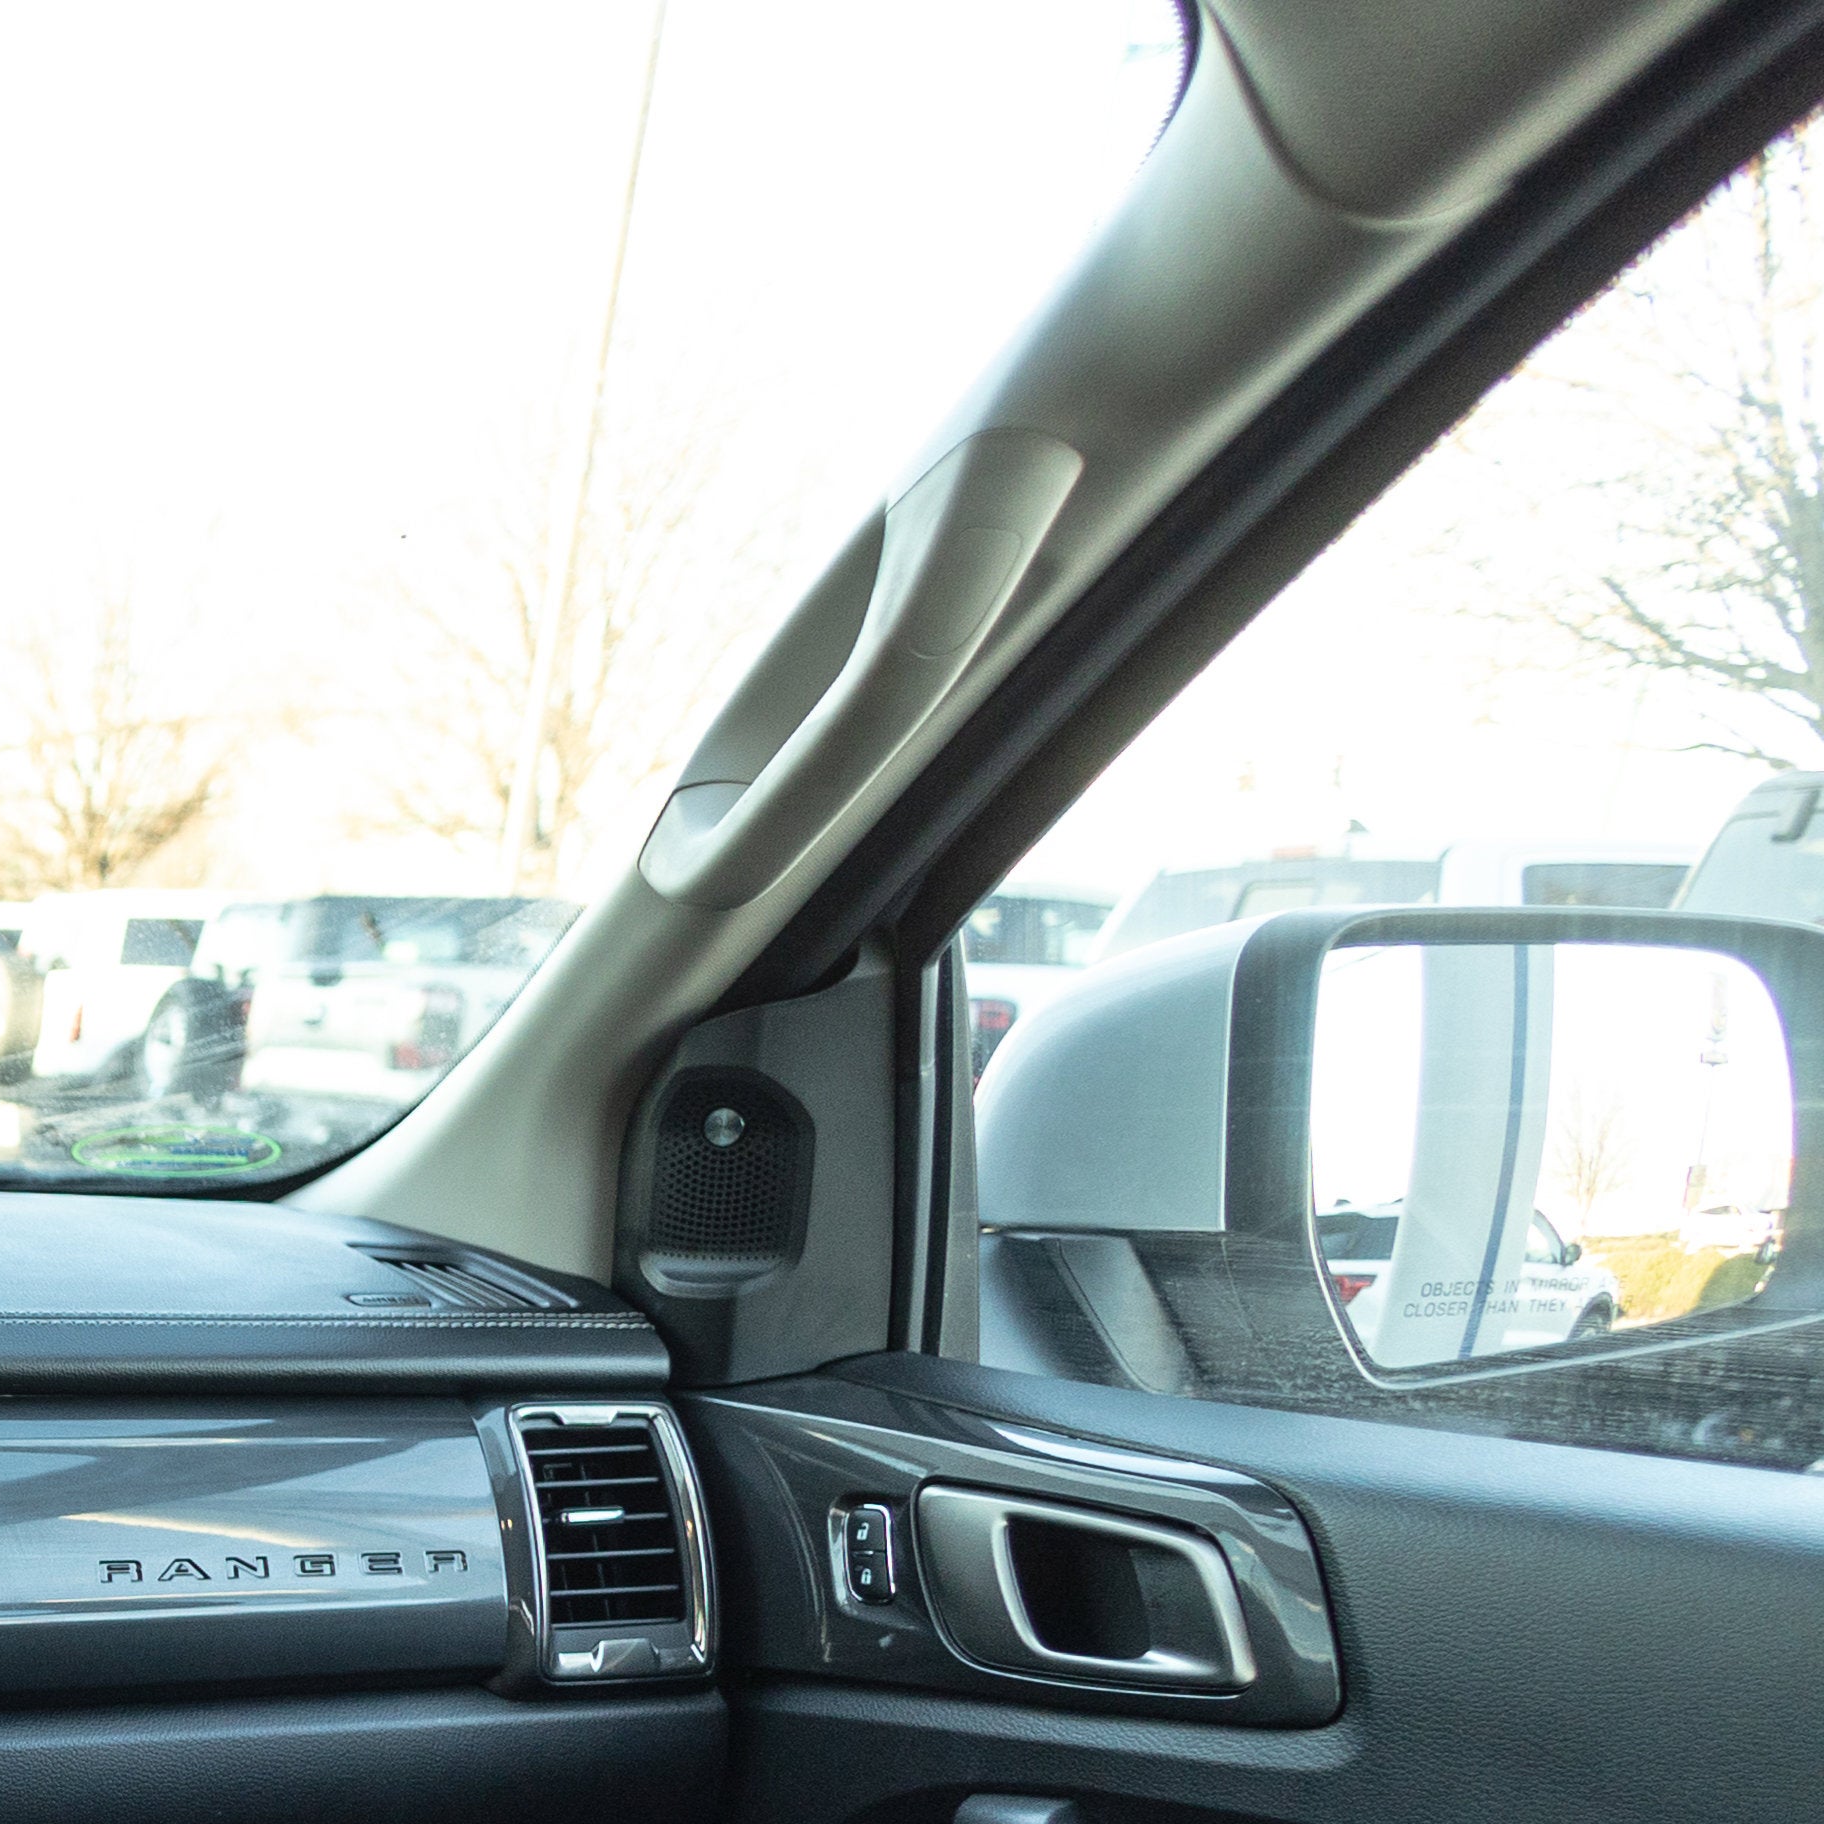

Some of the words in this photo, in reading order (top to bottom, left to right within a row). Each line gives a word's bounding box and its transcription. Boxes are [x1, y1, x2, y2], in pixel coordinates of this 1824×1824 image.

[1504, 1279, 1520, 1293] IN
[1403, 1300, 1468, 1318] CLOSER
[1529, 1298, 1567, 1312] THEY
[98, 1549, 468, 1584] RANGER
